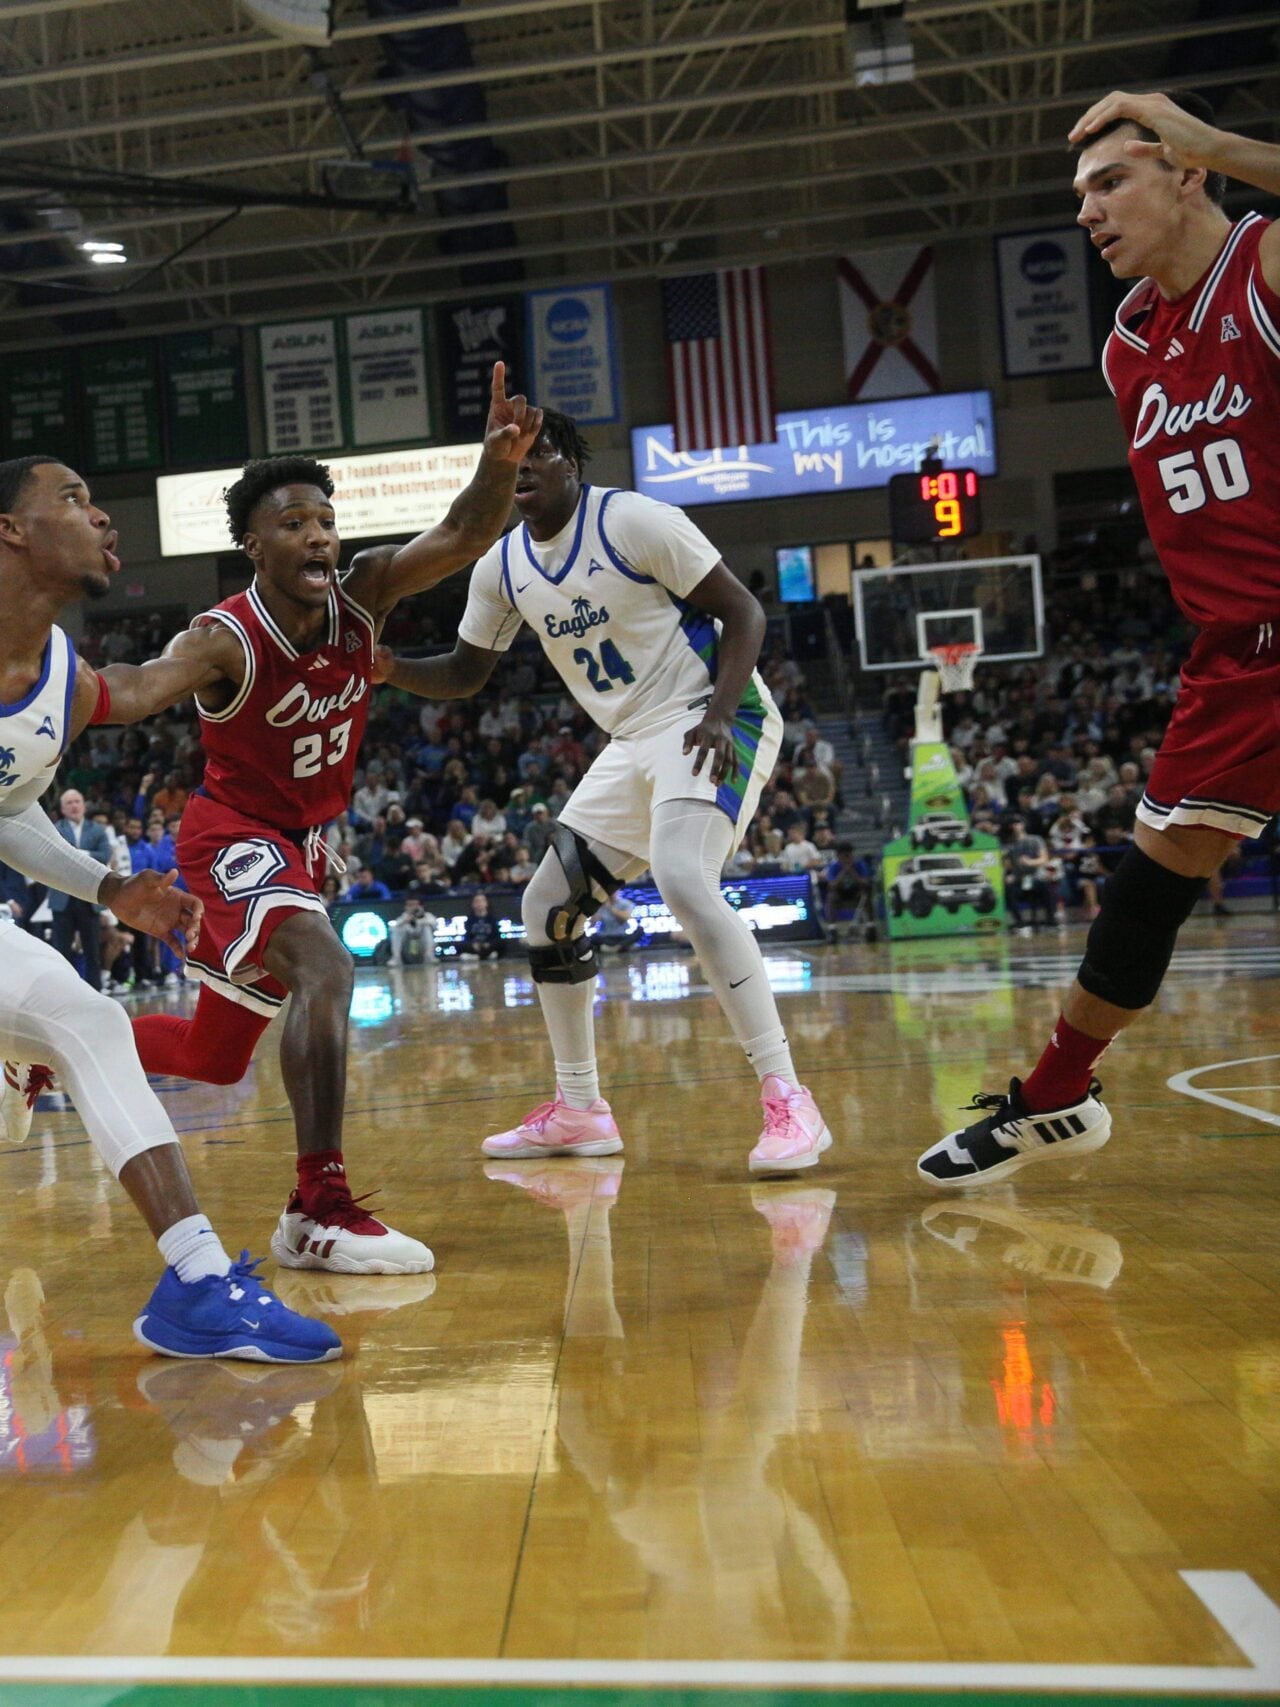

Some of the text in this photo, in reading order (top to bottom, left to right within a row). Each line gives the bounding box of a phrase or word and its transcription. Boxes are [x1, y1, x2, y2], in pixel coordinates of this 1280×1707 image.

[271, 333, 327, 350] ASUN
[359, 323, 415, 339] ASUN
[776, 412, 896, 450] This is
[1133, 374, 1252, 450] Owls
[793, 424, 992, 485] my hosptal.
[331, 485, 376, 502] oncrete
[696, 472, 750, 485] Healthcare
[713, 481, 750, 494] System
[920, 471, 977, 501] 1:01
[1158, 438, 1250, 514] 50
[934, 498, 962, 538] 9
[543, 597, 610, 640] Eagles
[572, 638, 637, 693] 24
[265, 673, 369, 728] Owls
[292, 718, 353, 780] 23
